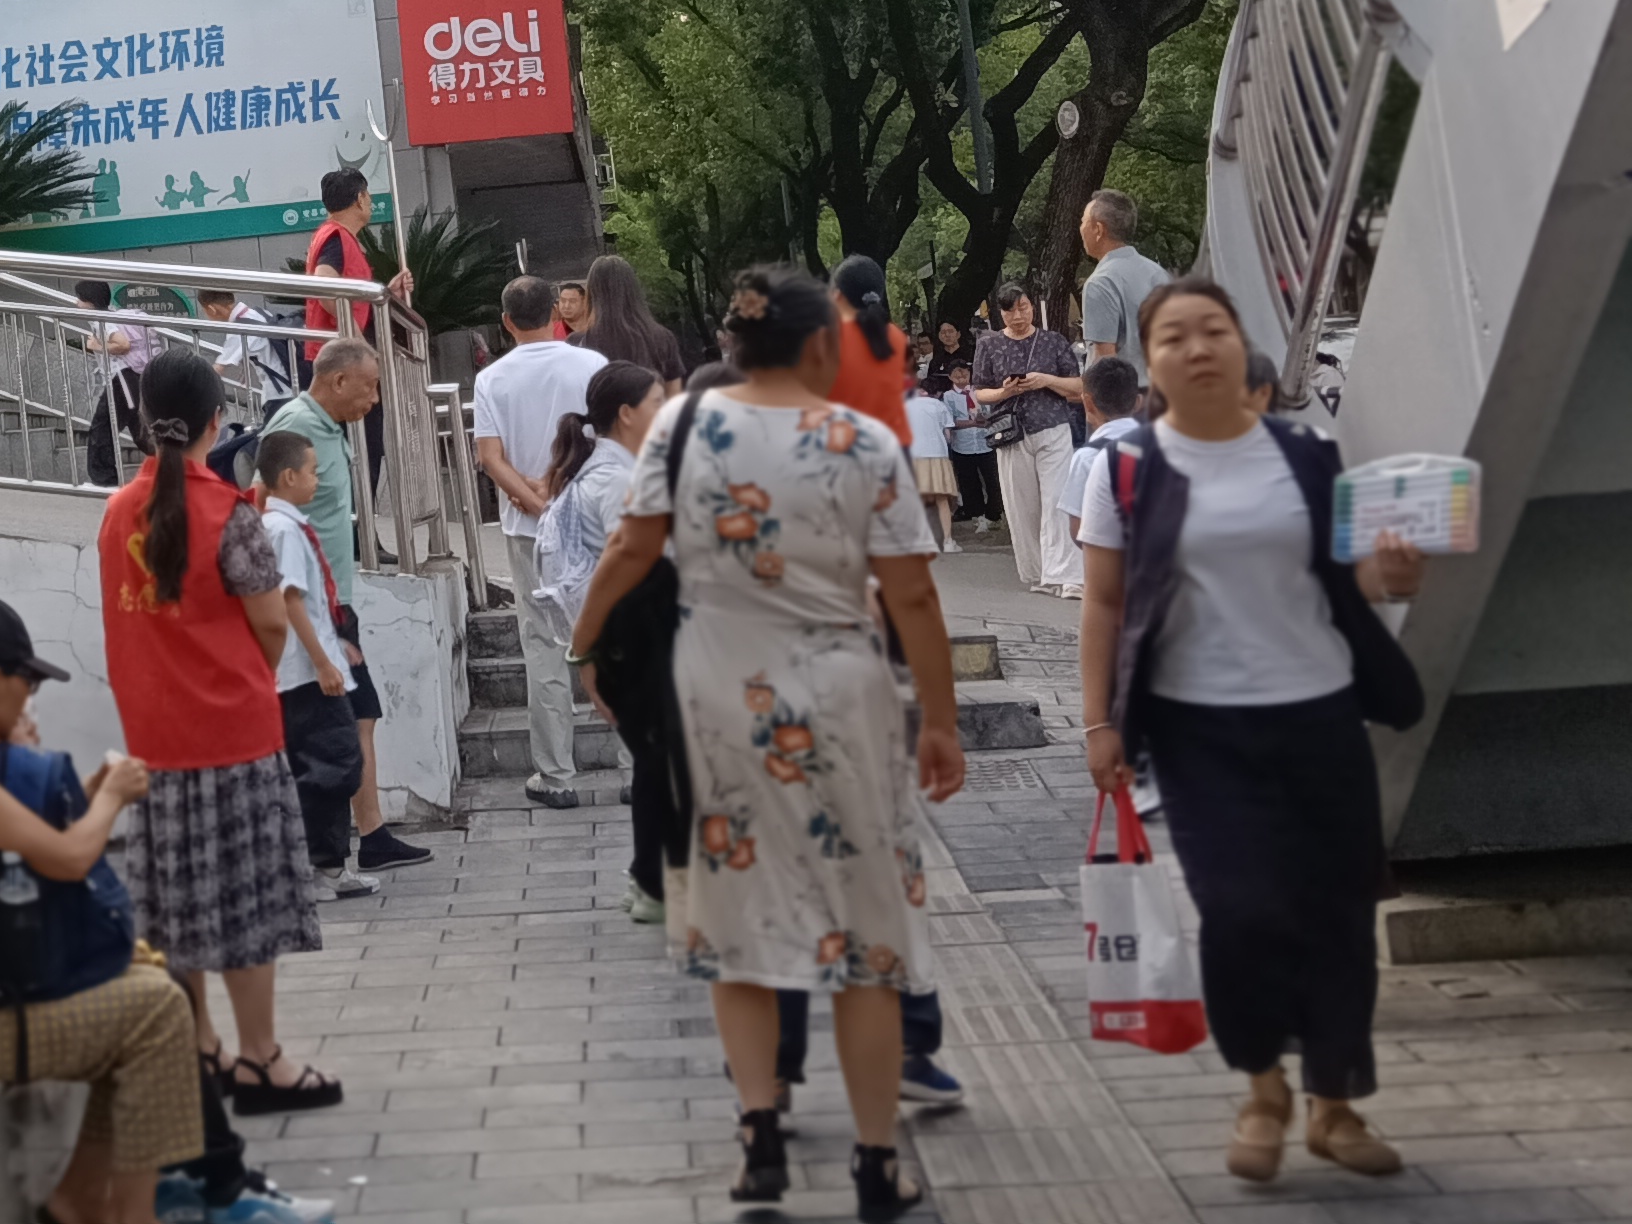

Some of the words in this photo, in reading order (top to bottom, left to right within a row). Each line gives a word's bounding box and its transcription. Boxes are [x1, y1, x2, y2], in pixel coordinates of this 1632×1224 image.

[424, 9, 541, 60] deli
[428, 56, 545, 93] 得力文具
